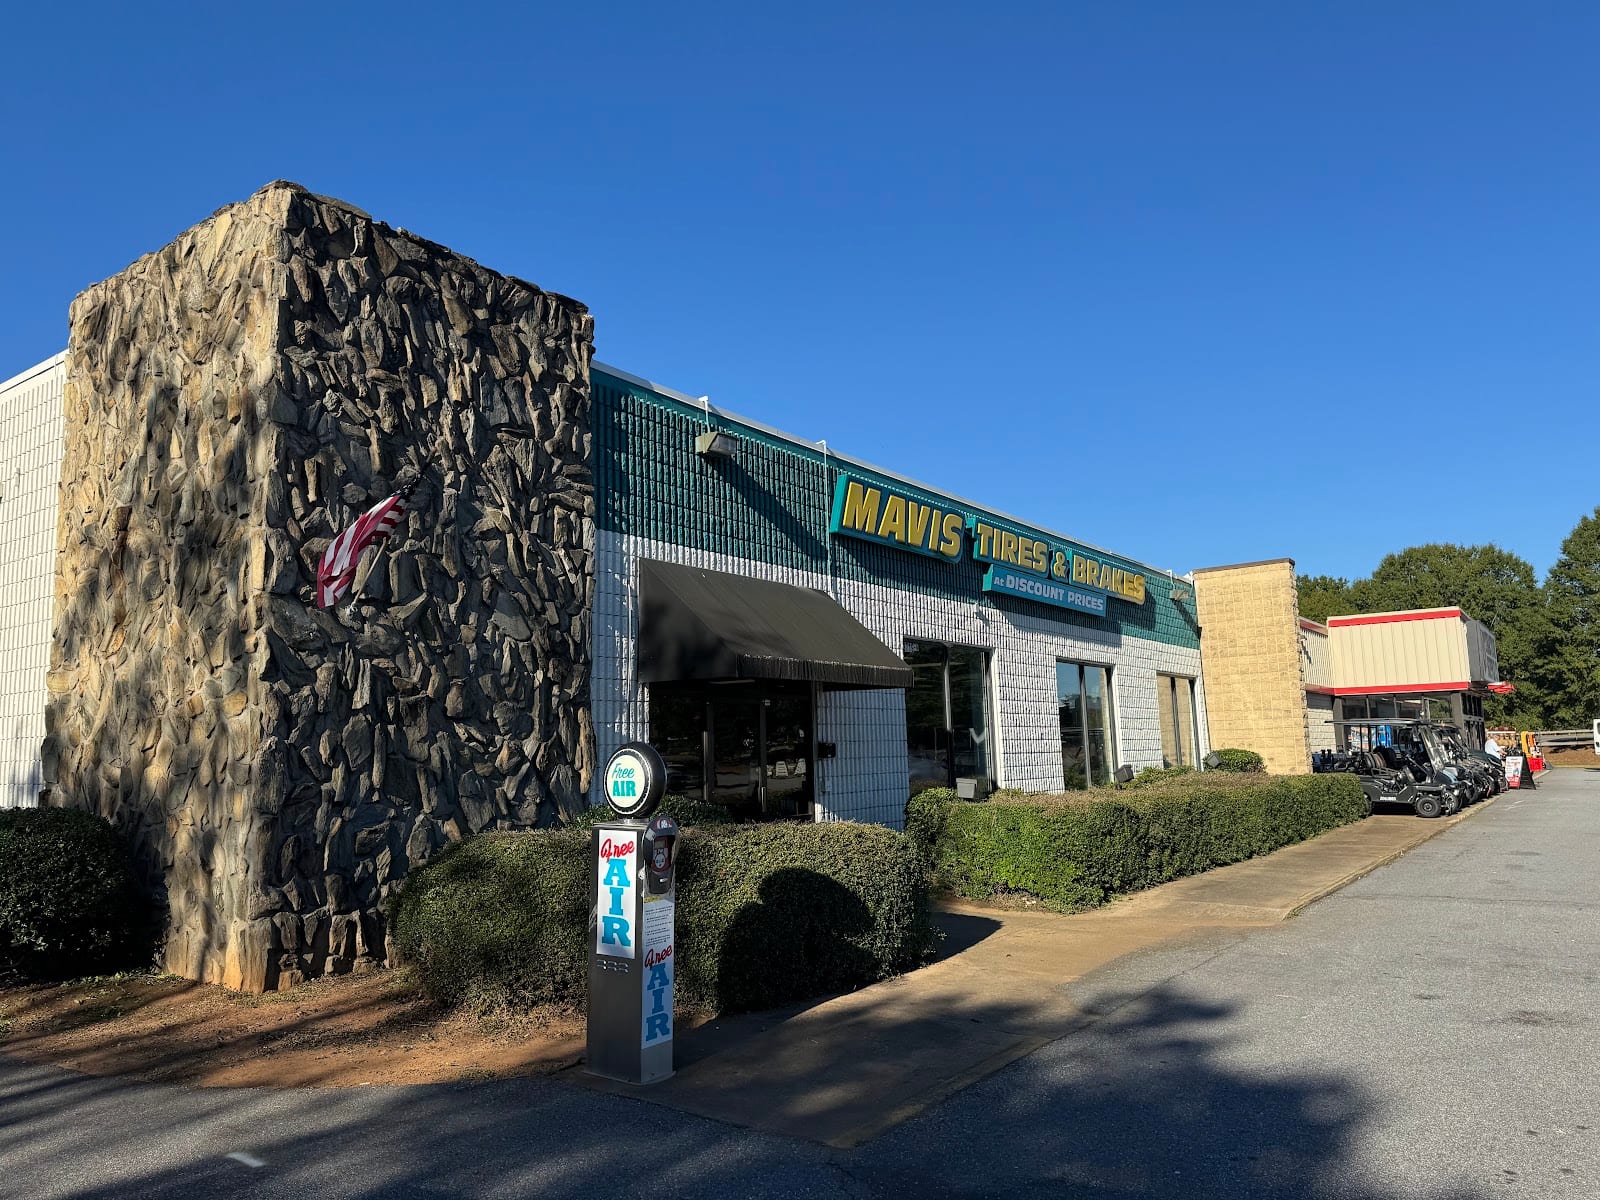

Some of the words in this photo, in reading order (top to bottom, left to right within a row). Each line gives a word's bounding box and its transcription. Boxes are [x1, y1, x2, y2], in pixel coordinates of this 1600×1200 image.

[843, 481, 963, 557] MAVIS
[977, 523, 1048, 573] TIRES
[1053, 551, 1069, 579] &
[1072, 554, 1145, 600] BRAKES
[1006, 574, 1065, 601] DISCOUNT
[1067, 591, 1104, 611] PRICES
[611, 763, 636, 779] Free
[612, 780, 636, 796] AIR
[600, 838, 635, 863] Free
[602, 858, 631, 947] AIR
[644, 945, 672, 970] Free
[645, 962, 670, 1041] AIR
